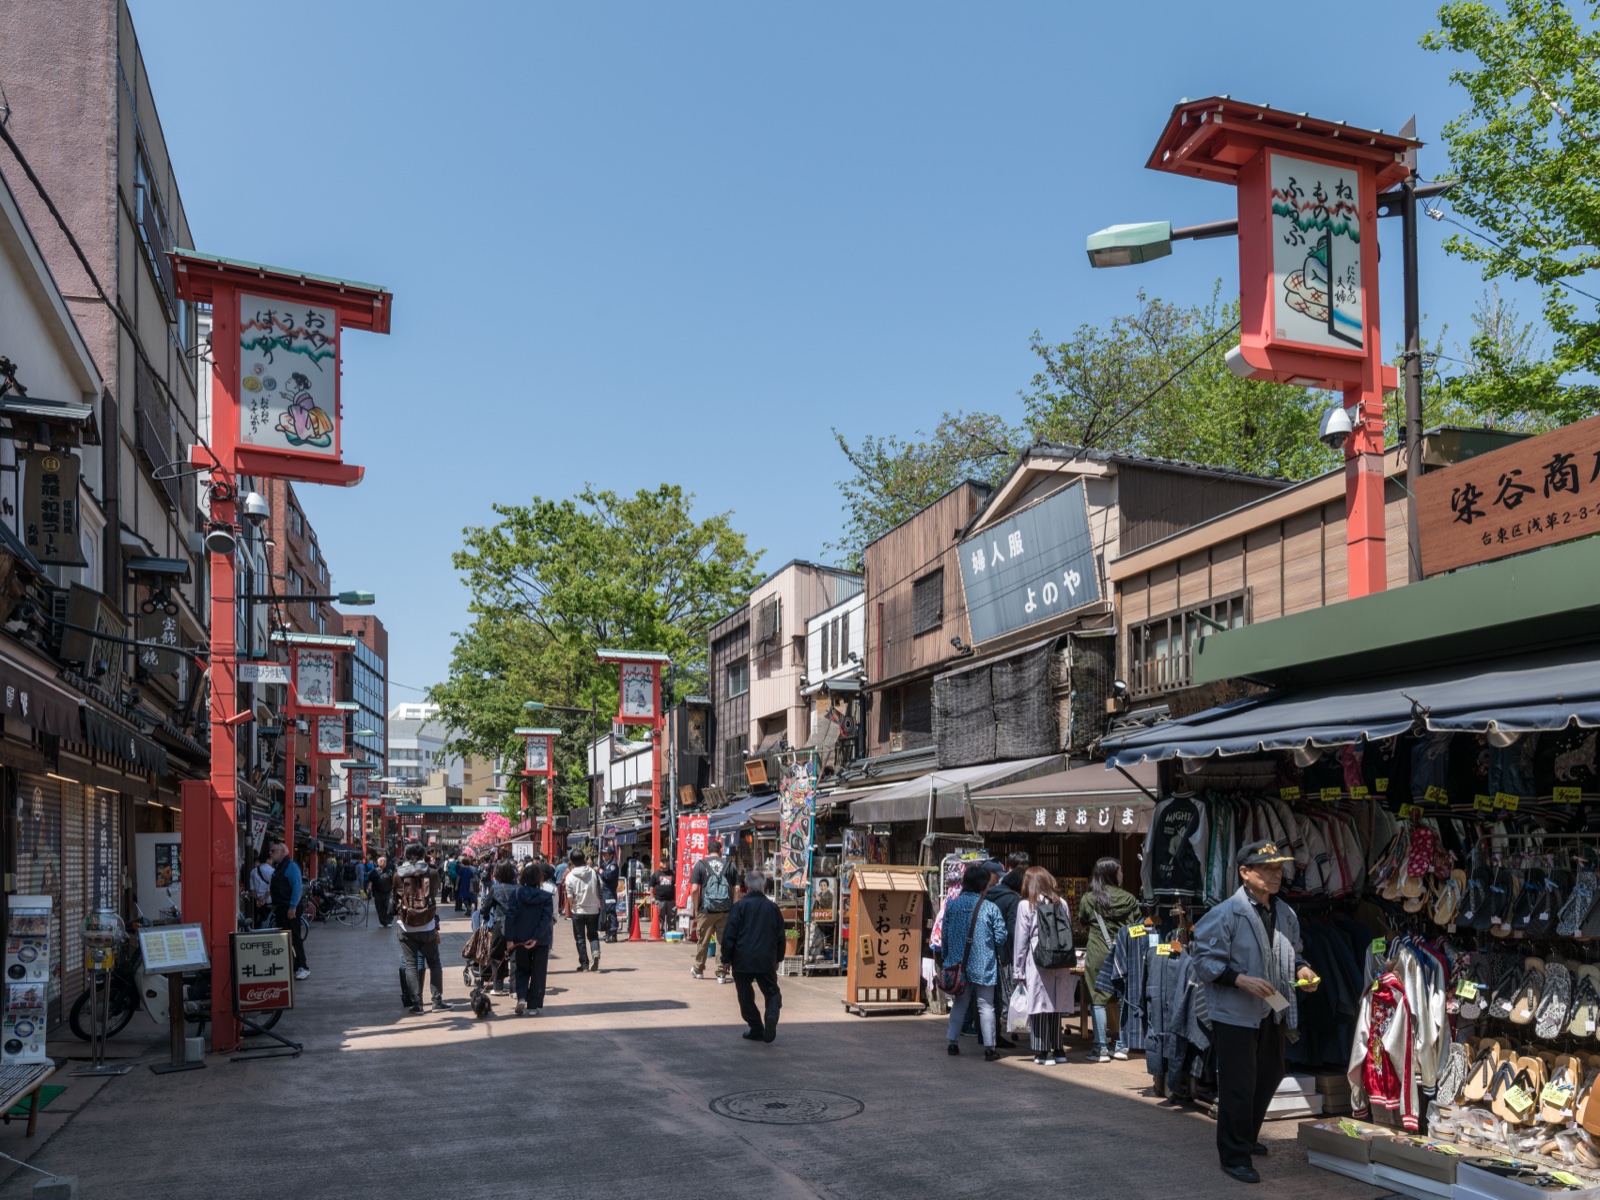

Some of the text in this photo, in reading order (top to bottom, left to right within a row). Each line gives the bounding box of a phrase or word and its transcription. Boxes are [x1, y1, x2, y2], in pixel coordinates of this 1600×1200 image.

[1312, 181, 1330, 223] もの
[1334, 178, 1354, 222] ねた
[256, 309, 278, 365] ばっかり
[971, 530, 1025, 575] 婦人服
[1024, 568, 1081, 614] よのや
[161, 617, 177, 646] 宝飾
[1035, 806, 1134, 827] 浅草おじま
[240, 941, 273, 950] COFFEE
[262, 947, 284, 956] SHOP
[875, 892, 891, 979] 浅草おじま
[897, 914, 912, 970] 切子の店
[246, 986, 281, 1001] Coca-Cola
